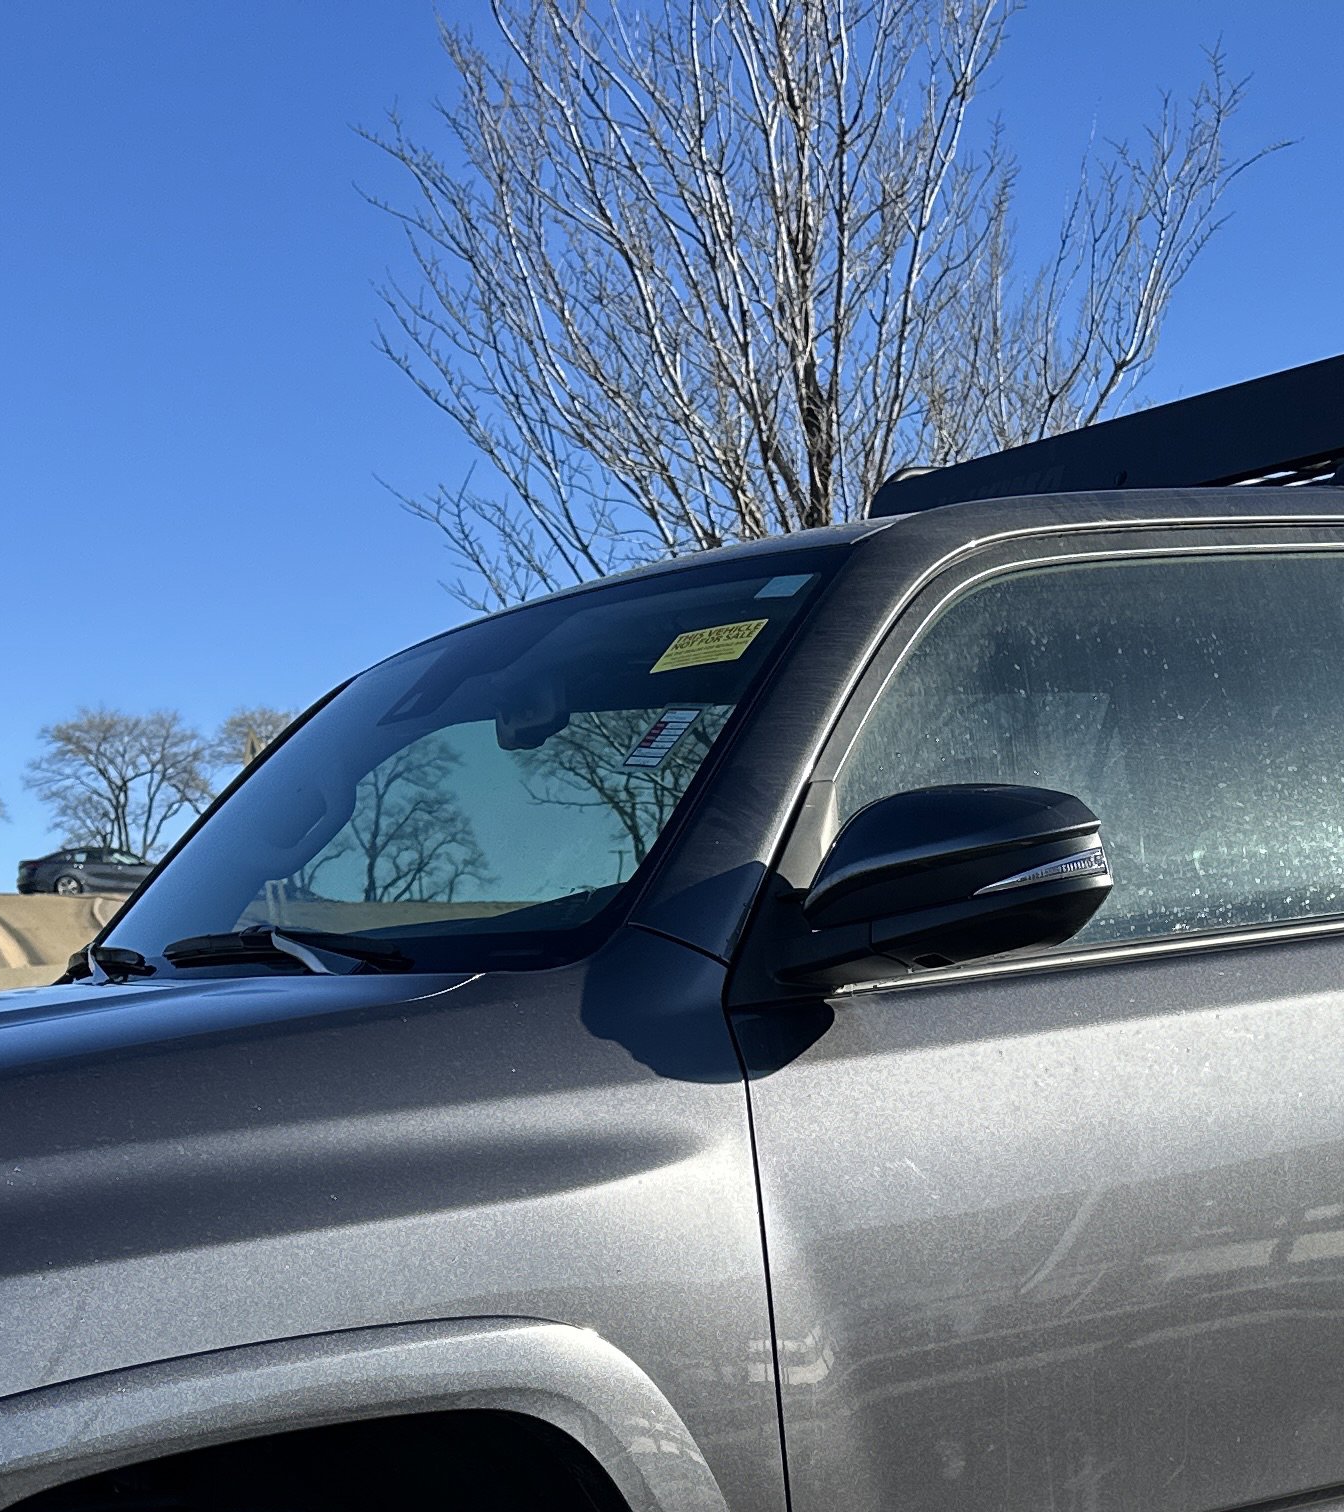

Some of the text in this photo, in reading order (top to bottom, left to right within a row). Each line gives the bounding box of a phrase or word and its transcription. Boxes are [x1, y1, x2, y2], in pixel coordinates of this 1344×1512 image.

[671, 630, 755, 651] NOT FOR SALE
[676, 622, 763, 644] THIS VEHICLE
